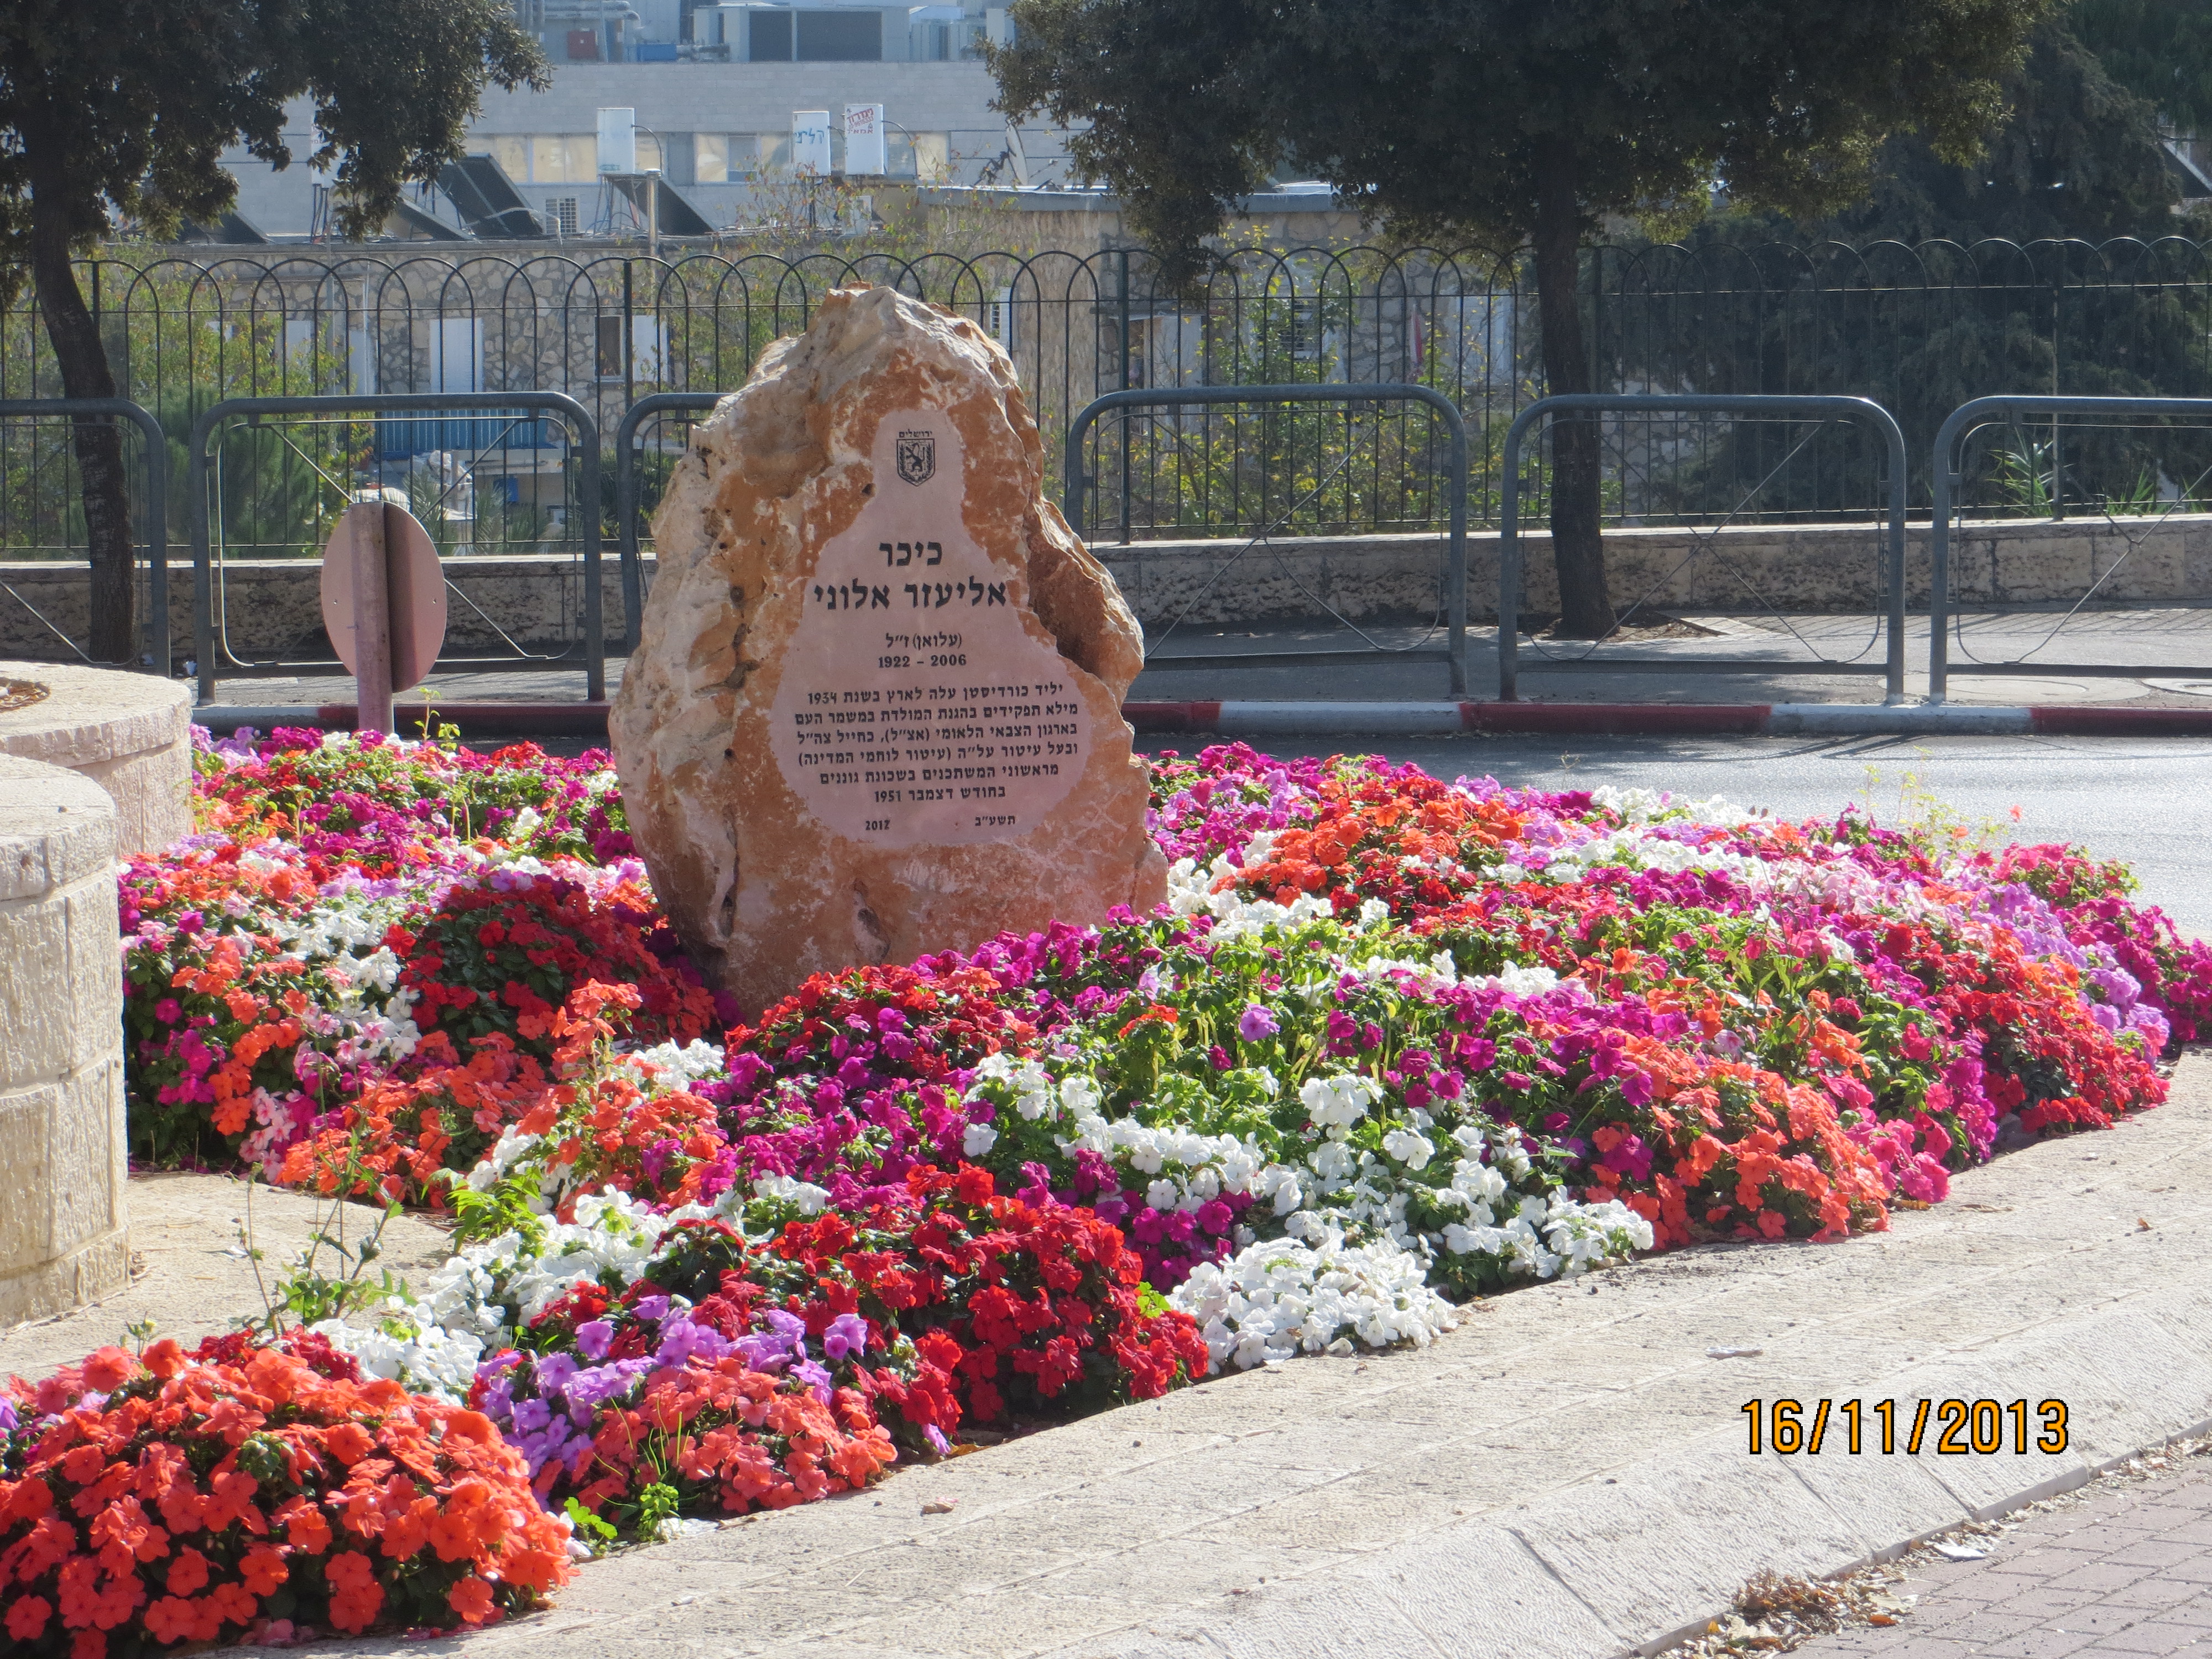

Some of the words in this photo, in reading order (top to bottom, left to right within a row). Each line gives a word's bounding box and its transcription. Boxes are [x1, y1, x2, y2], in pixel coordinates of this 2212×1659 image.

[899, 429, 933, 438] ירושלים
[879, 541, 942, 567] כיכר
[813, 577, 890, 611] אלוני
[904, 575, 1006, 609] אליעזר
[912, 631, 962, 651] (עלואן)
[878, 655, 910, 668] 1922
[931, 654, 967, 667] 2006
[886, 686, 922, 705] לארץ
[929, 685, 956, 700] עלה
[963, 685, 1029, 702] כורדיסטן
[1035, 681, 1063, 696] יליד
[807, 692, 837, 705] 1934
[843, 691, 880, 703] בשנת
[880, 706, 932, 722] המולדת
[938, 707, 977, 719] בהגנת
[983, 705, 1040, 719] תפקידים
[1046, 701, 1078, 716] מילא
[795, 713, 823, 725] העם
[828, 711, 875, 723] במשמר
[797, 731, 831, 745] צה"ל
[936, 724, 984, 740] הלאומי
[990, 725, 1031, 738] הצבאי
[1037, 723, 1077, 739] בארגון
[860, 747, 899, 763] לוחמי
[906, 747, 951, 761] (עיטור
[957, 744, 994, 759] על"ה
[1001, 744, 1041, 757] עיטור
[1047, 741, 1078, 755] ובעל
[799, 752, 854, 767] המדינה)
[865, 770, 916, 783] בשכונת
[922, 766, 995, 780] המשתכנים
[1002, 764, 1058, 777] מראשוני
[820, 771, 859, 785] גוננים
[874, 790, 901, 803] 1951
[908, 788, 953, 801] דצמבר
[960, 786, 1006, 799] בחודש
